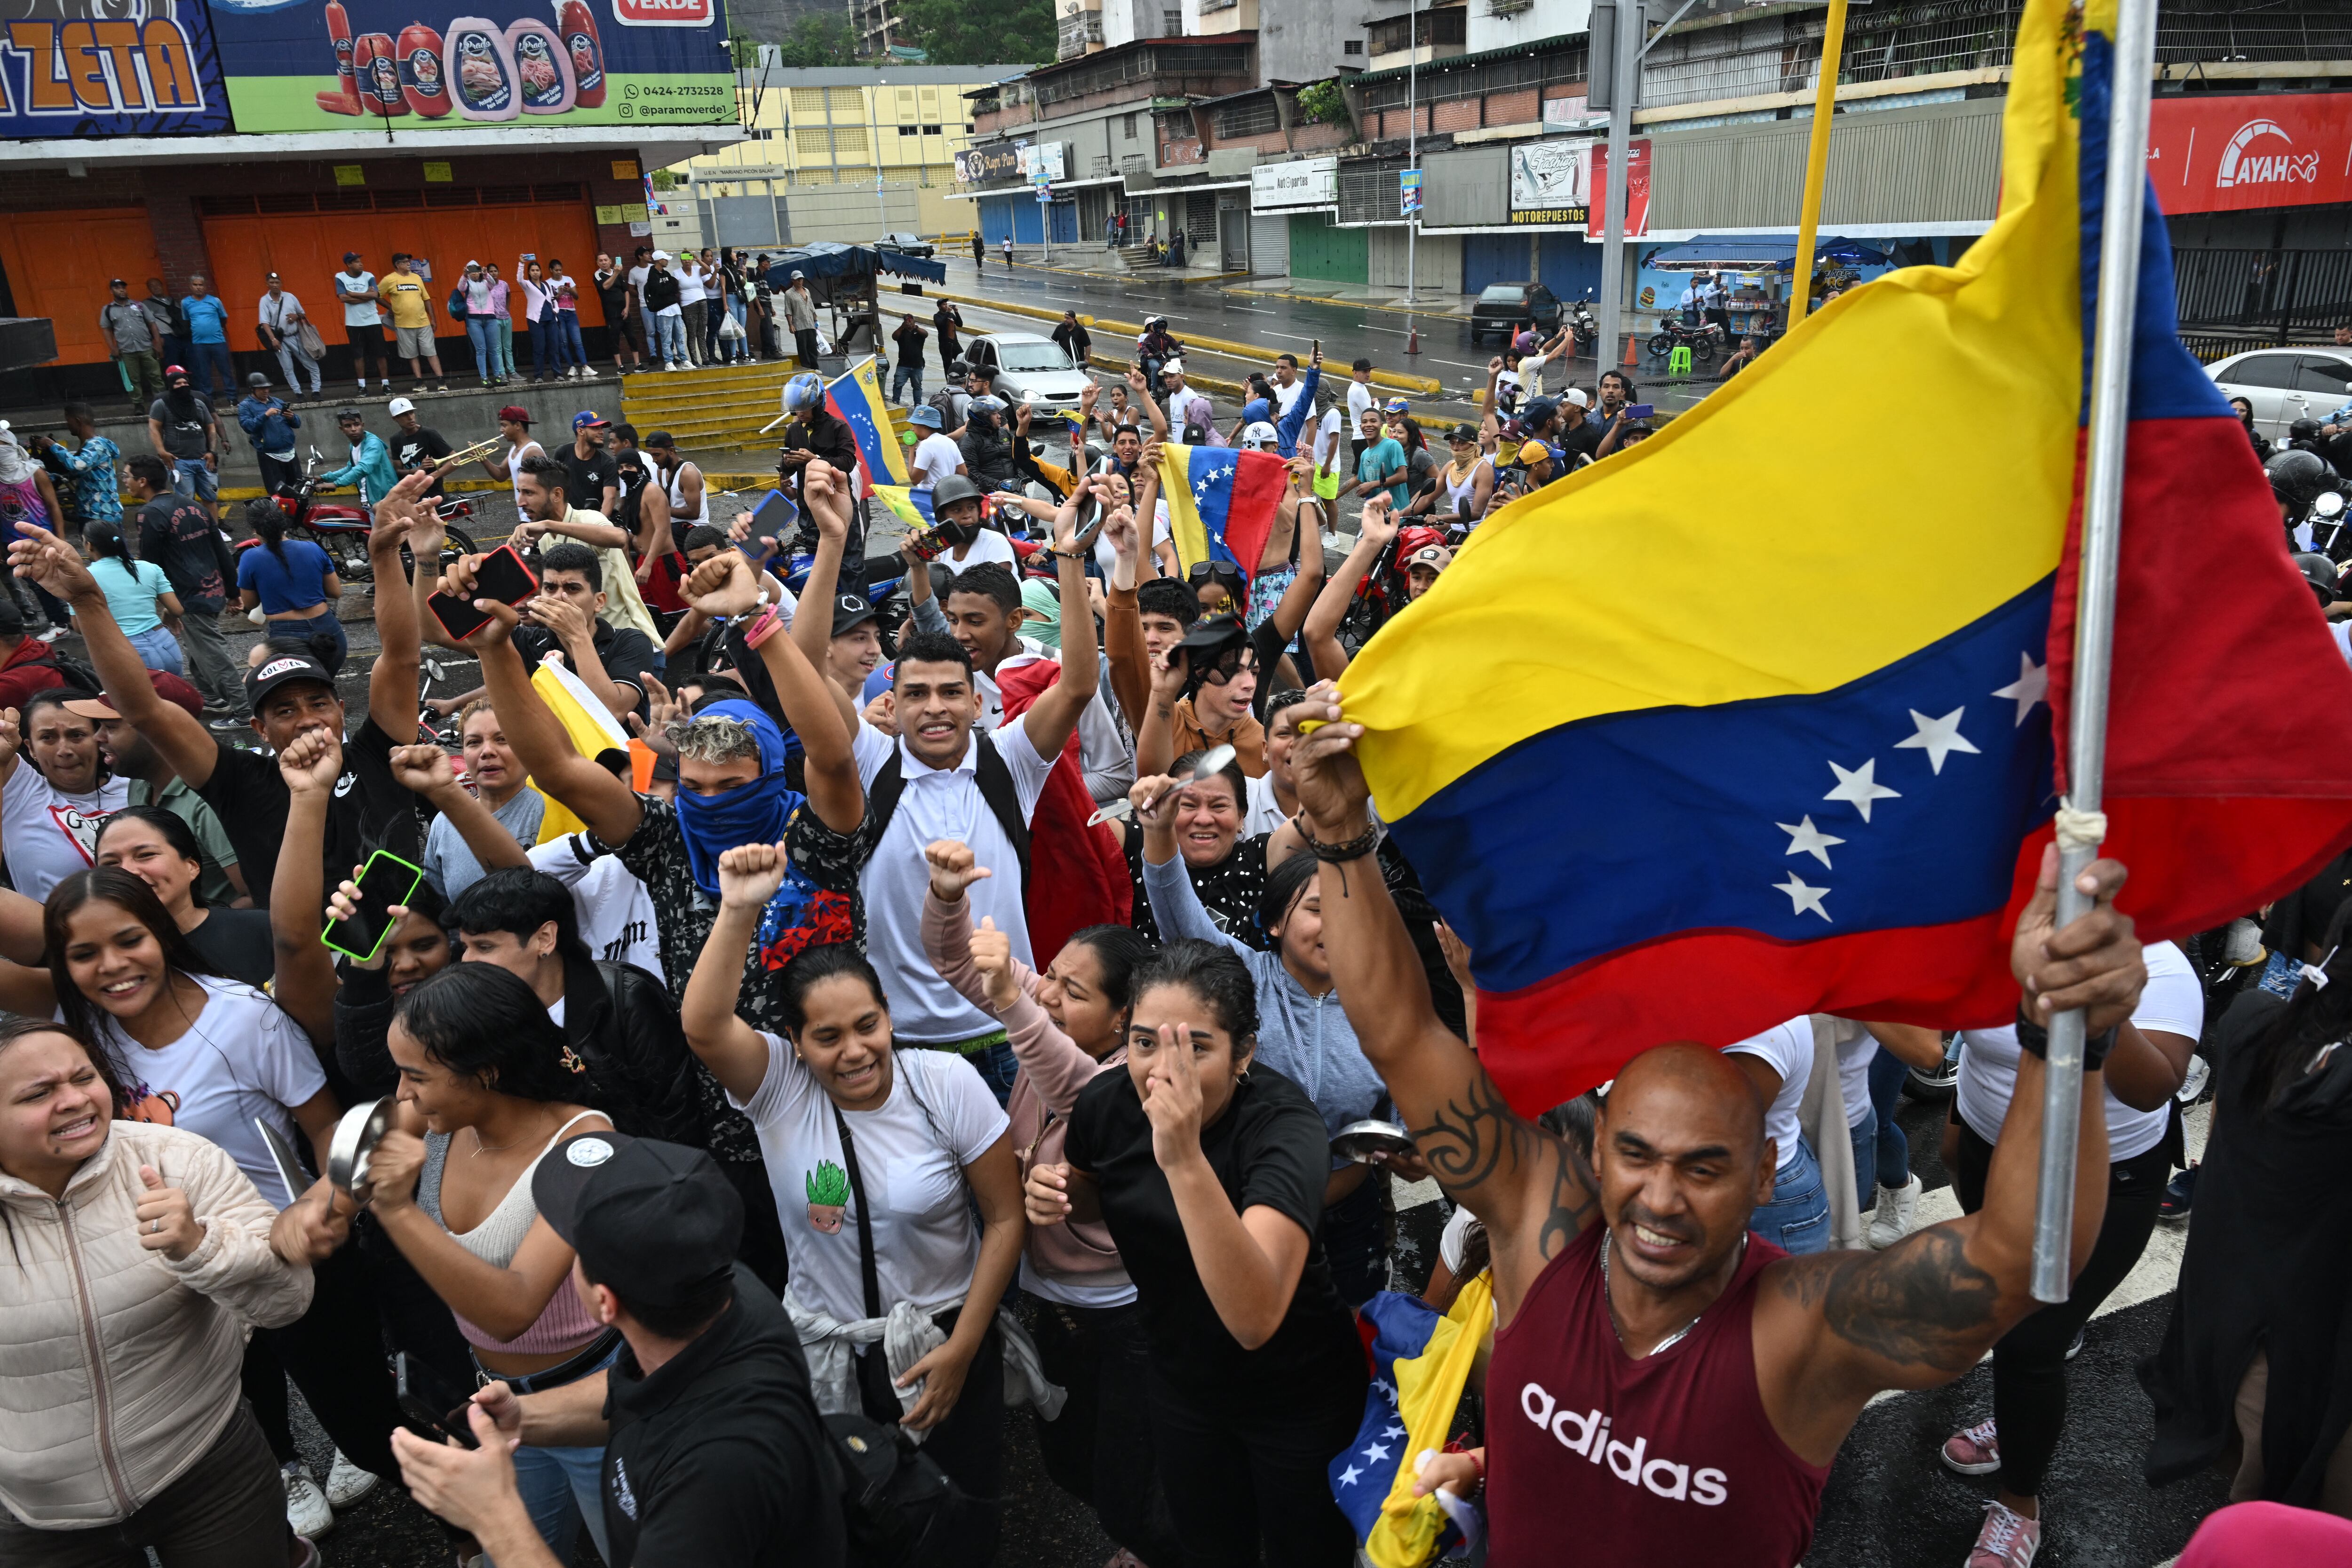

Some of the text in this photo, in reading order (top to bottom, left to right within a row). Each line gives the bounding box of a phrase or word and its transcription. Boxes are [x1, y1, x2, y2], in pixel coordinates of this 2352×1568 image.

[6, 18, 205, 114] ZETA
[644, 87, 723, 96] 0424-2732528
[640, 105, 726, 116] @paramoverde1
[985, 153, 1001, 176] Rapi
[1001, 152, 1016, 167] Pan
[1529, 145, 1578, 179] Fashion
[2236, 155, 2289, 184] AYAH
[1512, 209, 1584, 223] MOTOREPUESTOS
[402, 443, 418, 455] NIKE
[869, 587, 886, 596] ORSE
[337, 772, 353, 788] NIKE
[1521, 1382, 1727, 1505] adidas
